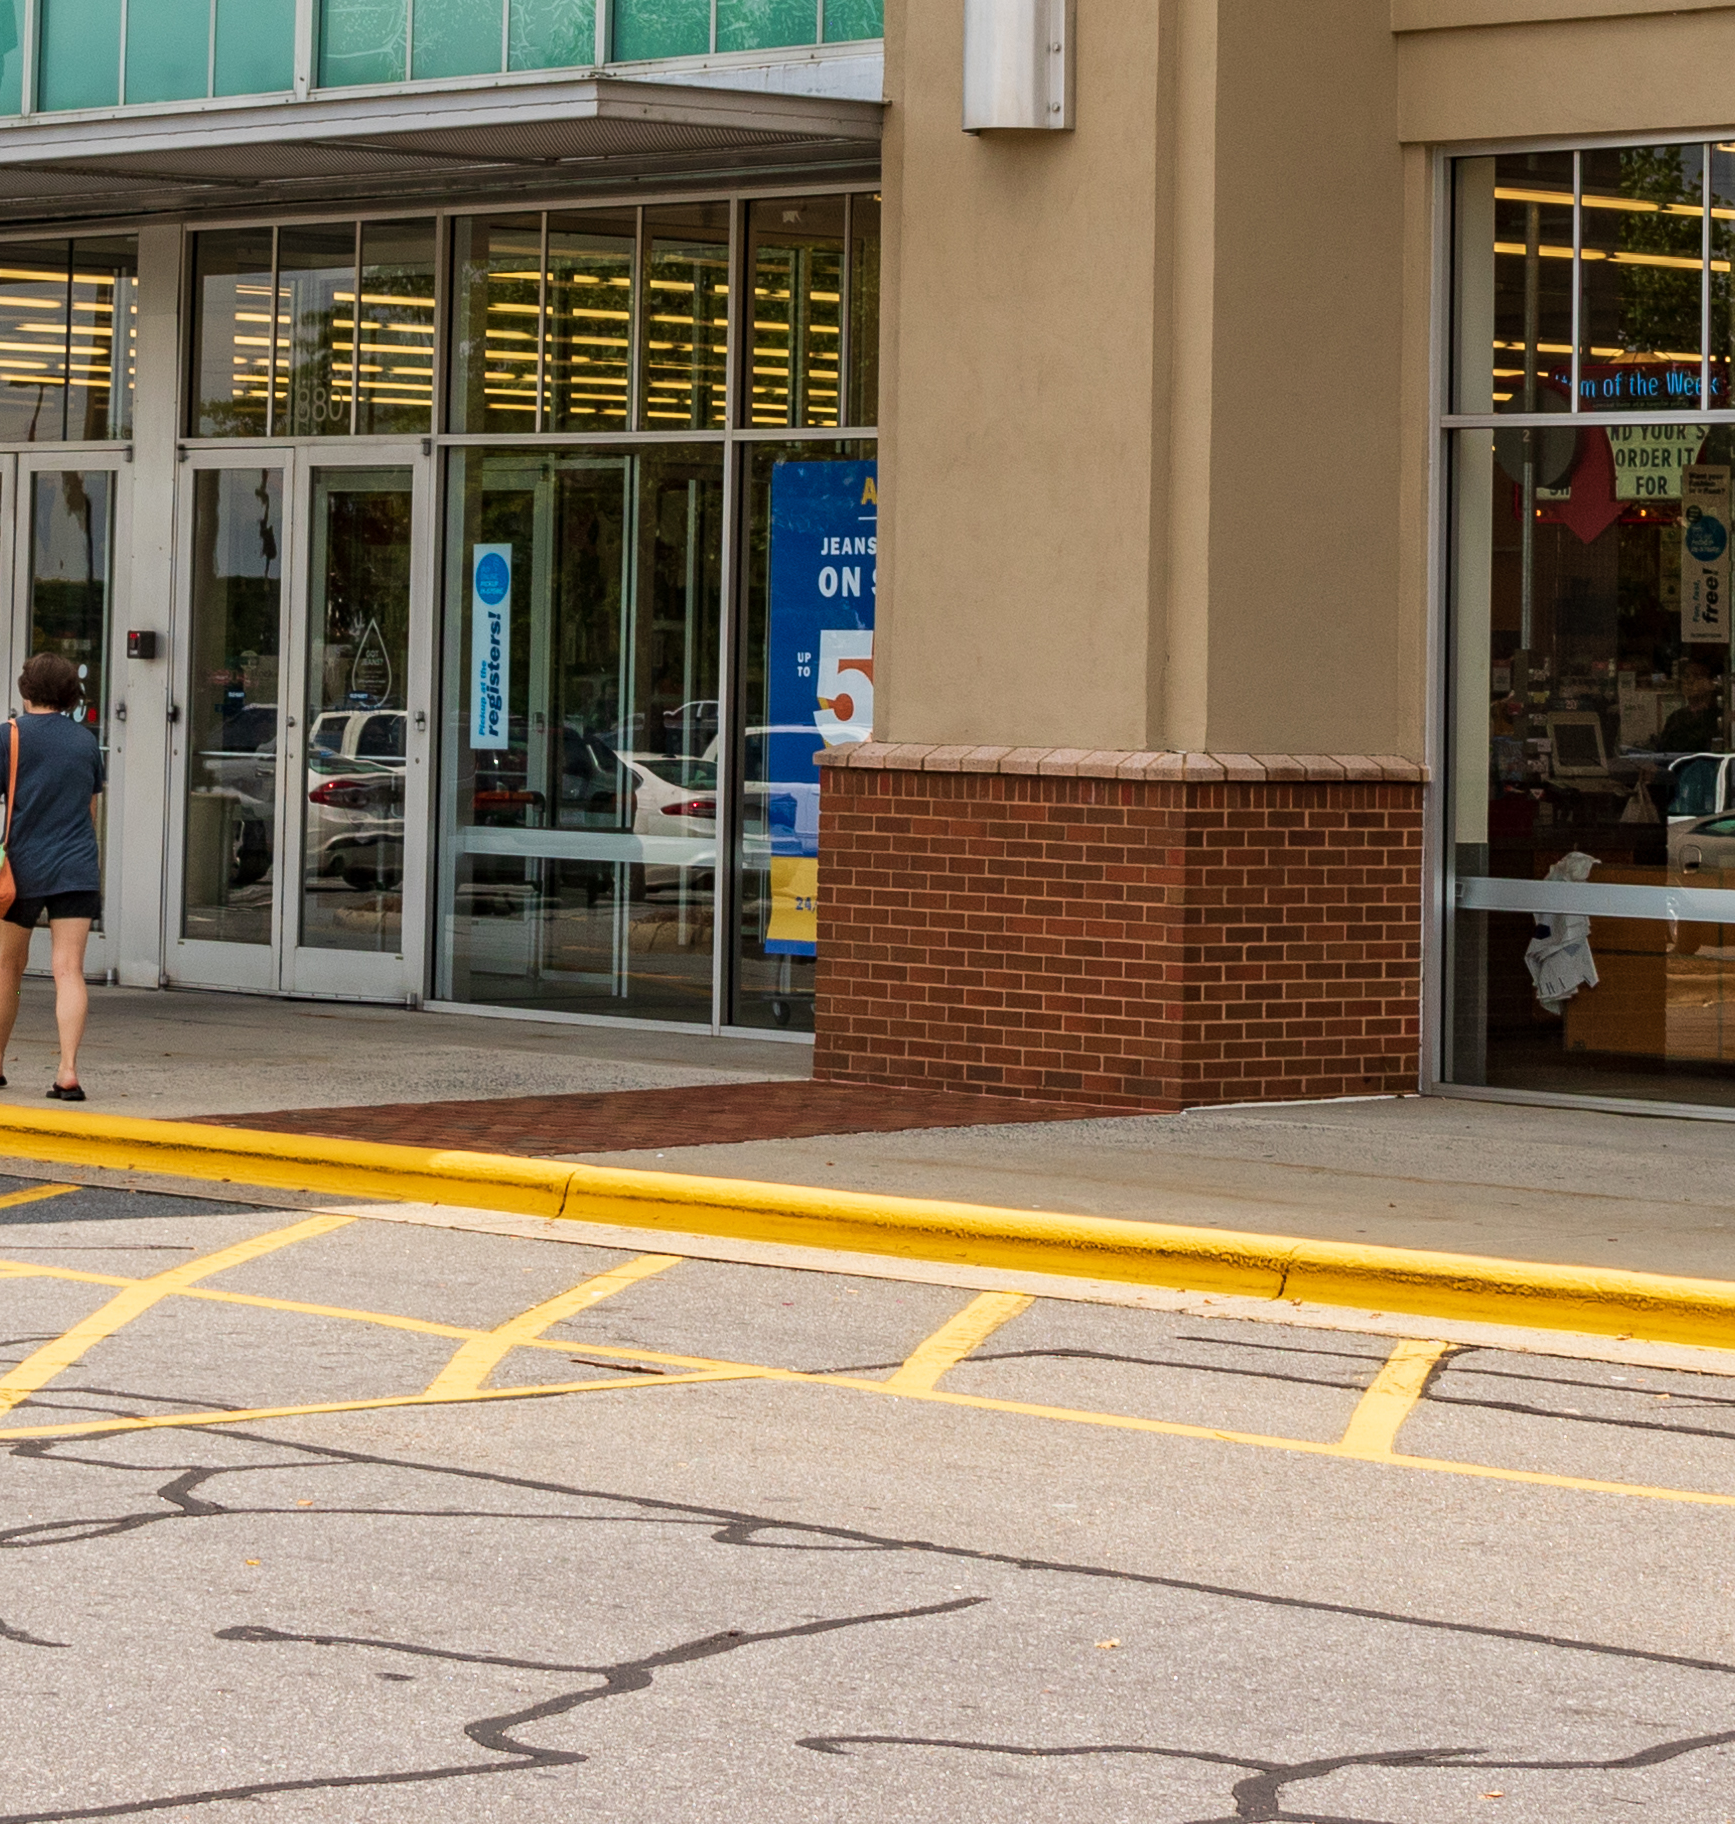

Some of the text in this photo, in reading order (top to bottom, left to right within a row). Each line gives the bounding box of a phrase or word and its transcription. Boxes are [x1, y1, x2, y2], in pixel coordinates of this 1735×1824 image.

[1603, 372, 1623, 397] of
[1630, 372, 1658, 396] the
[1522, 429, 1530, 442] 2
[1615, 448, 1694, 468] ORDER IT
[1636, 476, 1668, 496] FOR
[821, 537, 877, 555] JEANS
[818, 566, 861, 597] ON
[1702, 567, 1719, 623] free!
[797, 652, 812, 663] UP
[488, 611, 502, 737] registers!
[797, 666, 811, 677] TO
[813, 630, 874, 746] 5
[479, 696, 487, 736] Pickup
